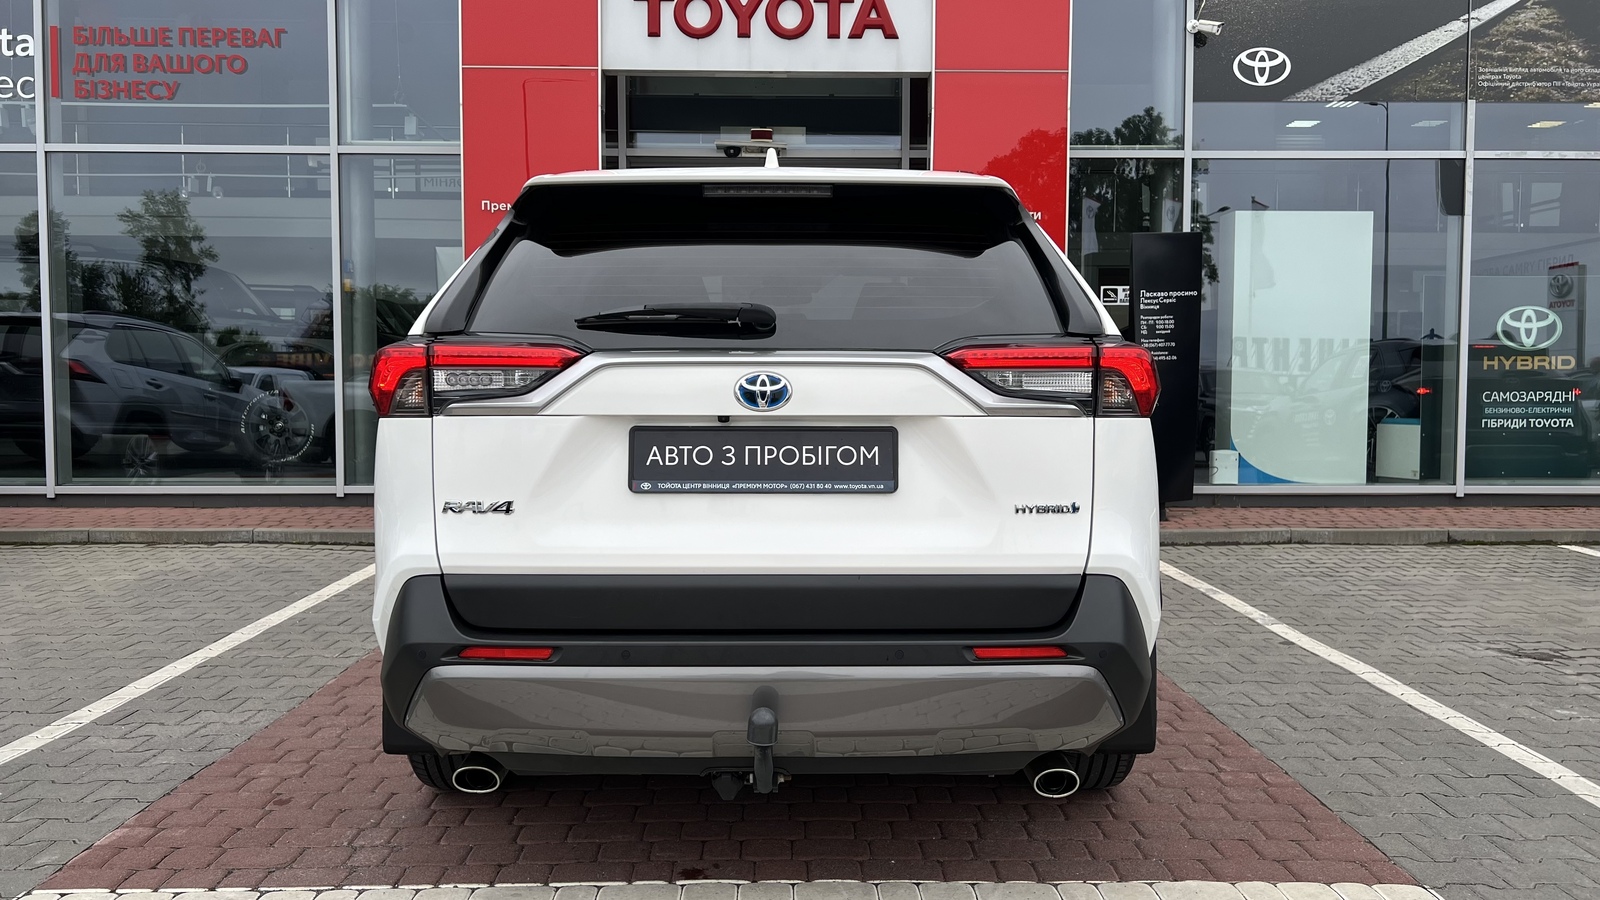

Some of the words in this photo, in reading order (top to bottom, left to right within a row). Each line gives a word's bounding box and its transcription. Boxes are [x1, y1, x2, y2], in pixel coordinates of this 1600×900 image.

[634, 0, 899, 40] TOYOTA
[0, 28, 34, 57] ta
[72, 26, 172, 46] БІЛЬШЕ
[178, 27, 286, 48] ПЕРЕВАГ
[72, 52, 126, 76] ДЛЯ
[132, 53, 247, 74] ВАШОГО
[74, 79, 179, 100] БІЗНЕСУ
[1140, 289, 1168, 298] Ласкаво
[1169, 290, 1198, 298] просимо
[1482, 355, 1576, 370] HYBRID
[1482, 390, 1575, 403] САМОЗАРЯДНІ
[1481, 418, 1527, 429] ГІБРИДИ
[1528, 418, 1574, 428] TOYOTA
[645, 445, 713, 466] АВТО
[721, 445, 736, 466] З
[744, 445, 880, 466] ПРОБІГОМ
[682, 482, 702, 490] ЦЕНТР
[702, 482, 730, 490] ВІННИЦЯ
[789, 482, 805, 490] (067)
[441, 500, 515, 515] RAV4
[1014, 504, 1071, 515] HYBRID
